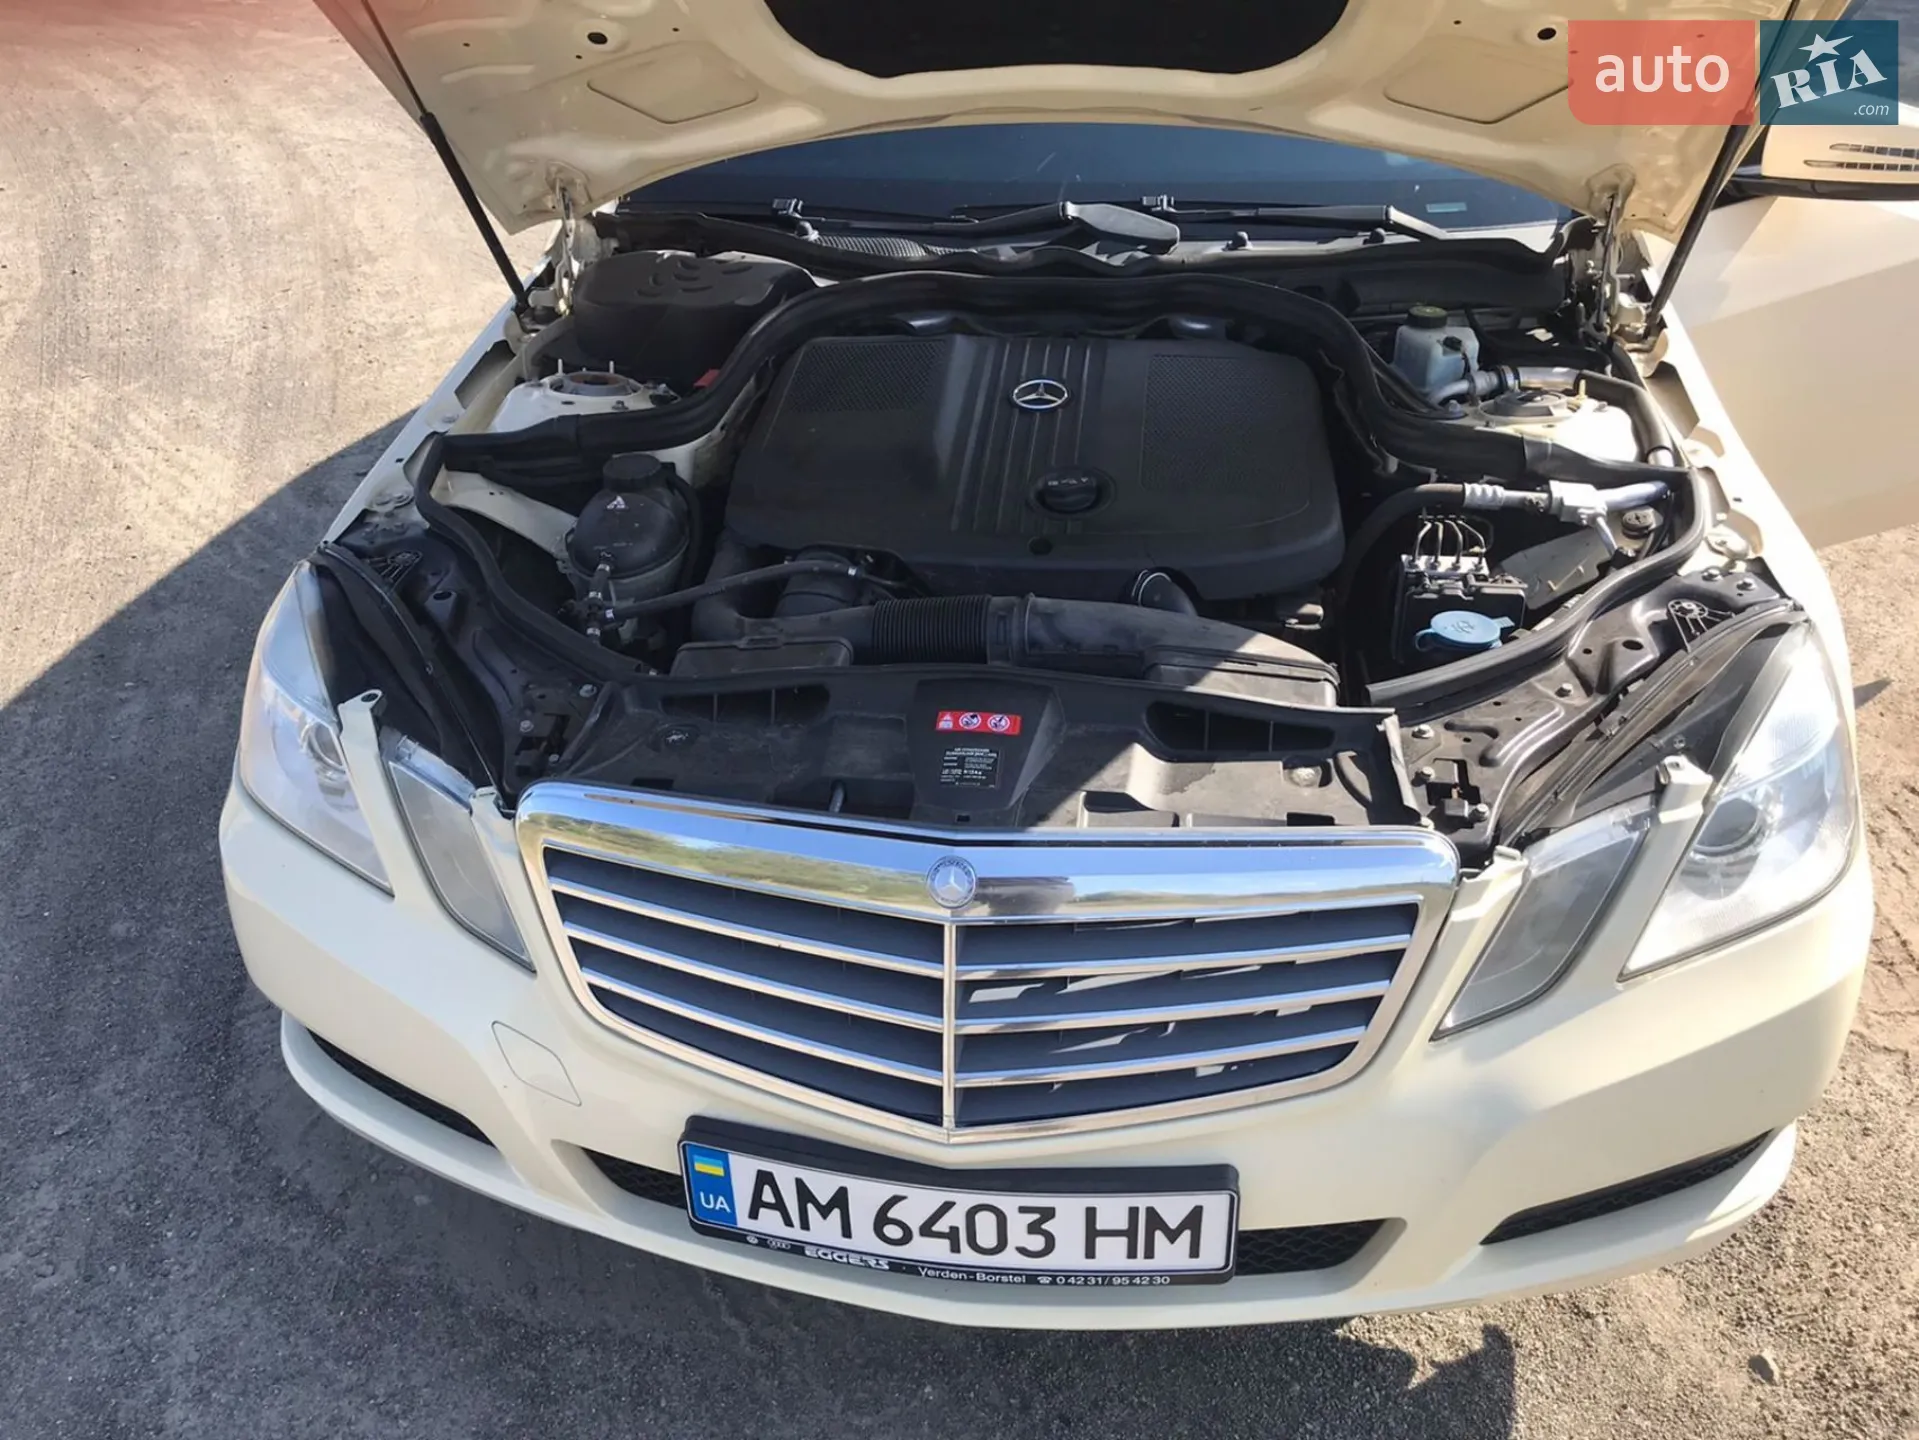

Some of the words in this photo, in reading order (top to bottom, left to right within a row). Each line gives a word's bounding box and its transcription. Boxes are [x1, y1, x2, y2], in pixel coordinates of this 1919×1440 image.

[699, 1191, 731, 1214] UA
[748, 1169, 852, 1239] AM
[873, 1194, 1056, 1259] 6403
[1084, 1205, 1204, 1260] HM
